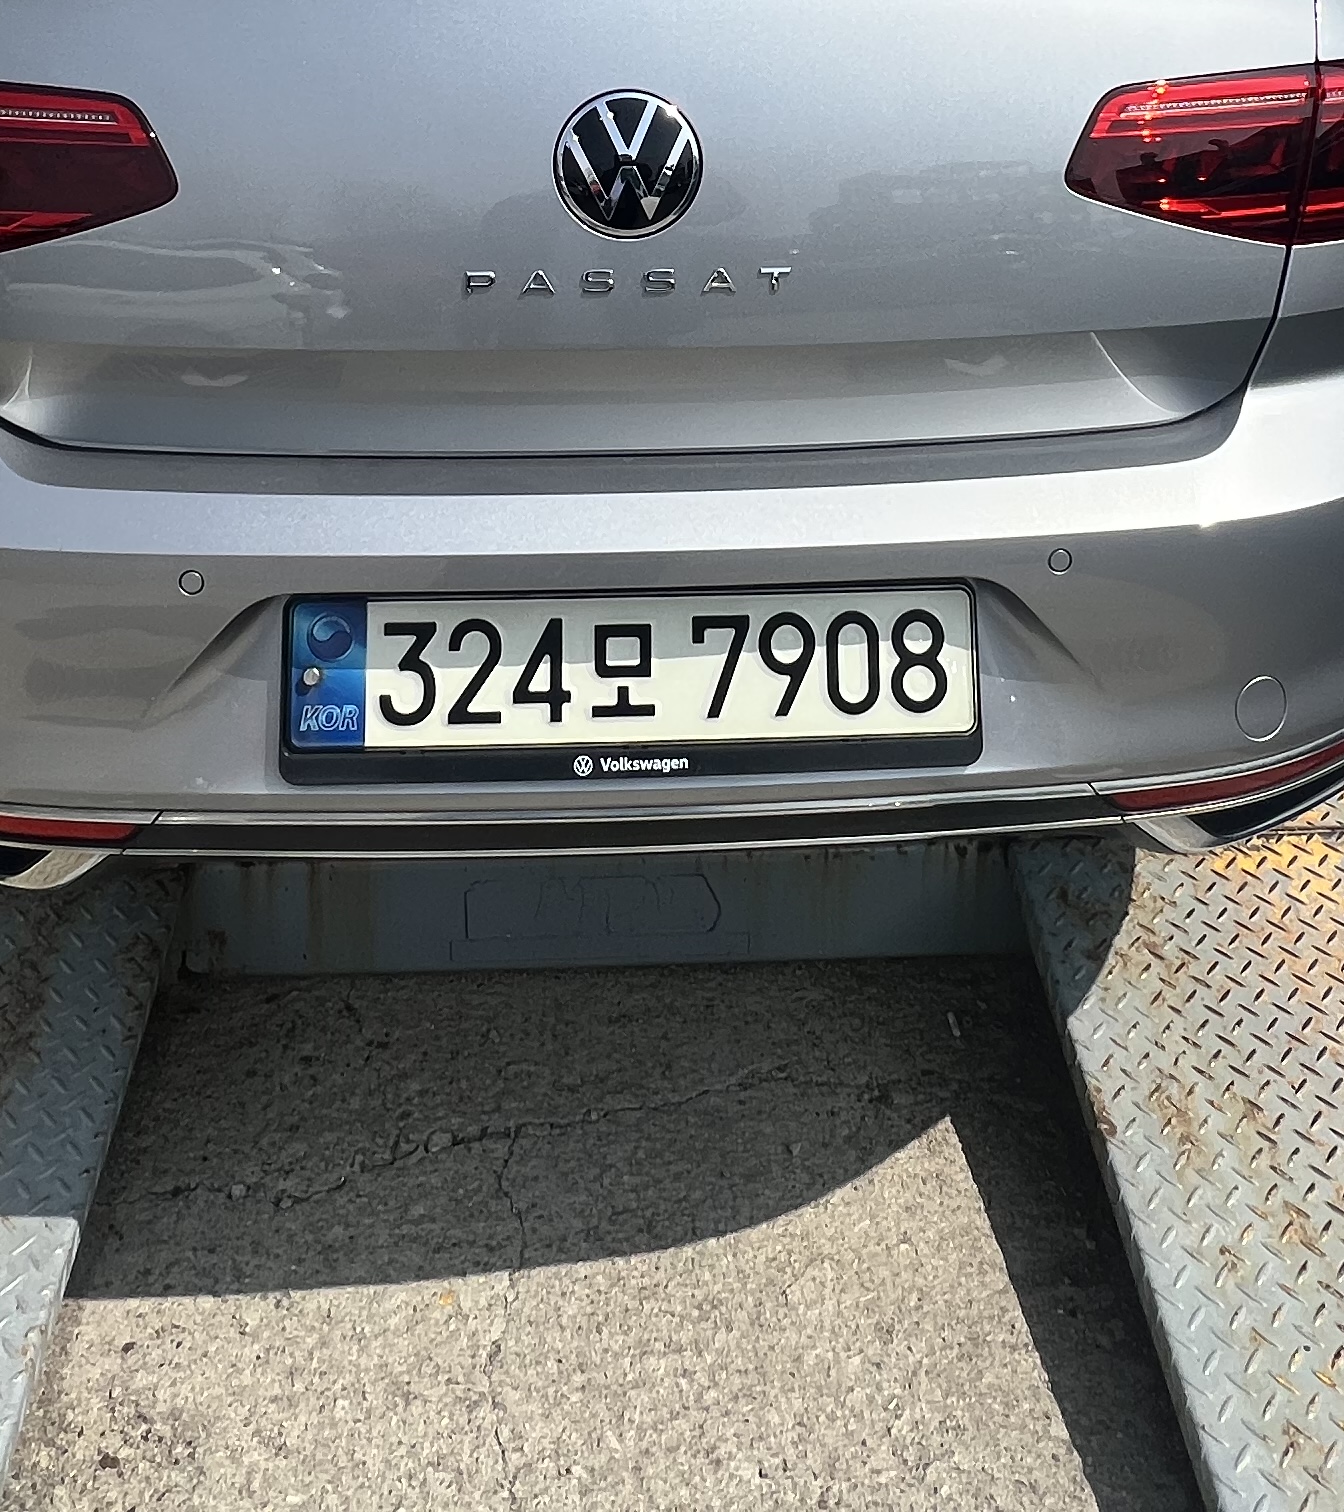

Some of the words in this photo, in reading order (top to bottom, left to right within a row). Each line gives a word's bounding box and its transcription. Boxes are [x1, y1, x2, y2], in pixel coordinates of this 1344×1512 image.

[464, 265, 792, 294] PASSAT
[378, 616, 656, 726] 324모
[690, 608, 946, 720] 7908
[299, 704, 359, 731] KOR
[599, 756, 689, 773] Volkswagen
